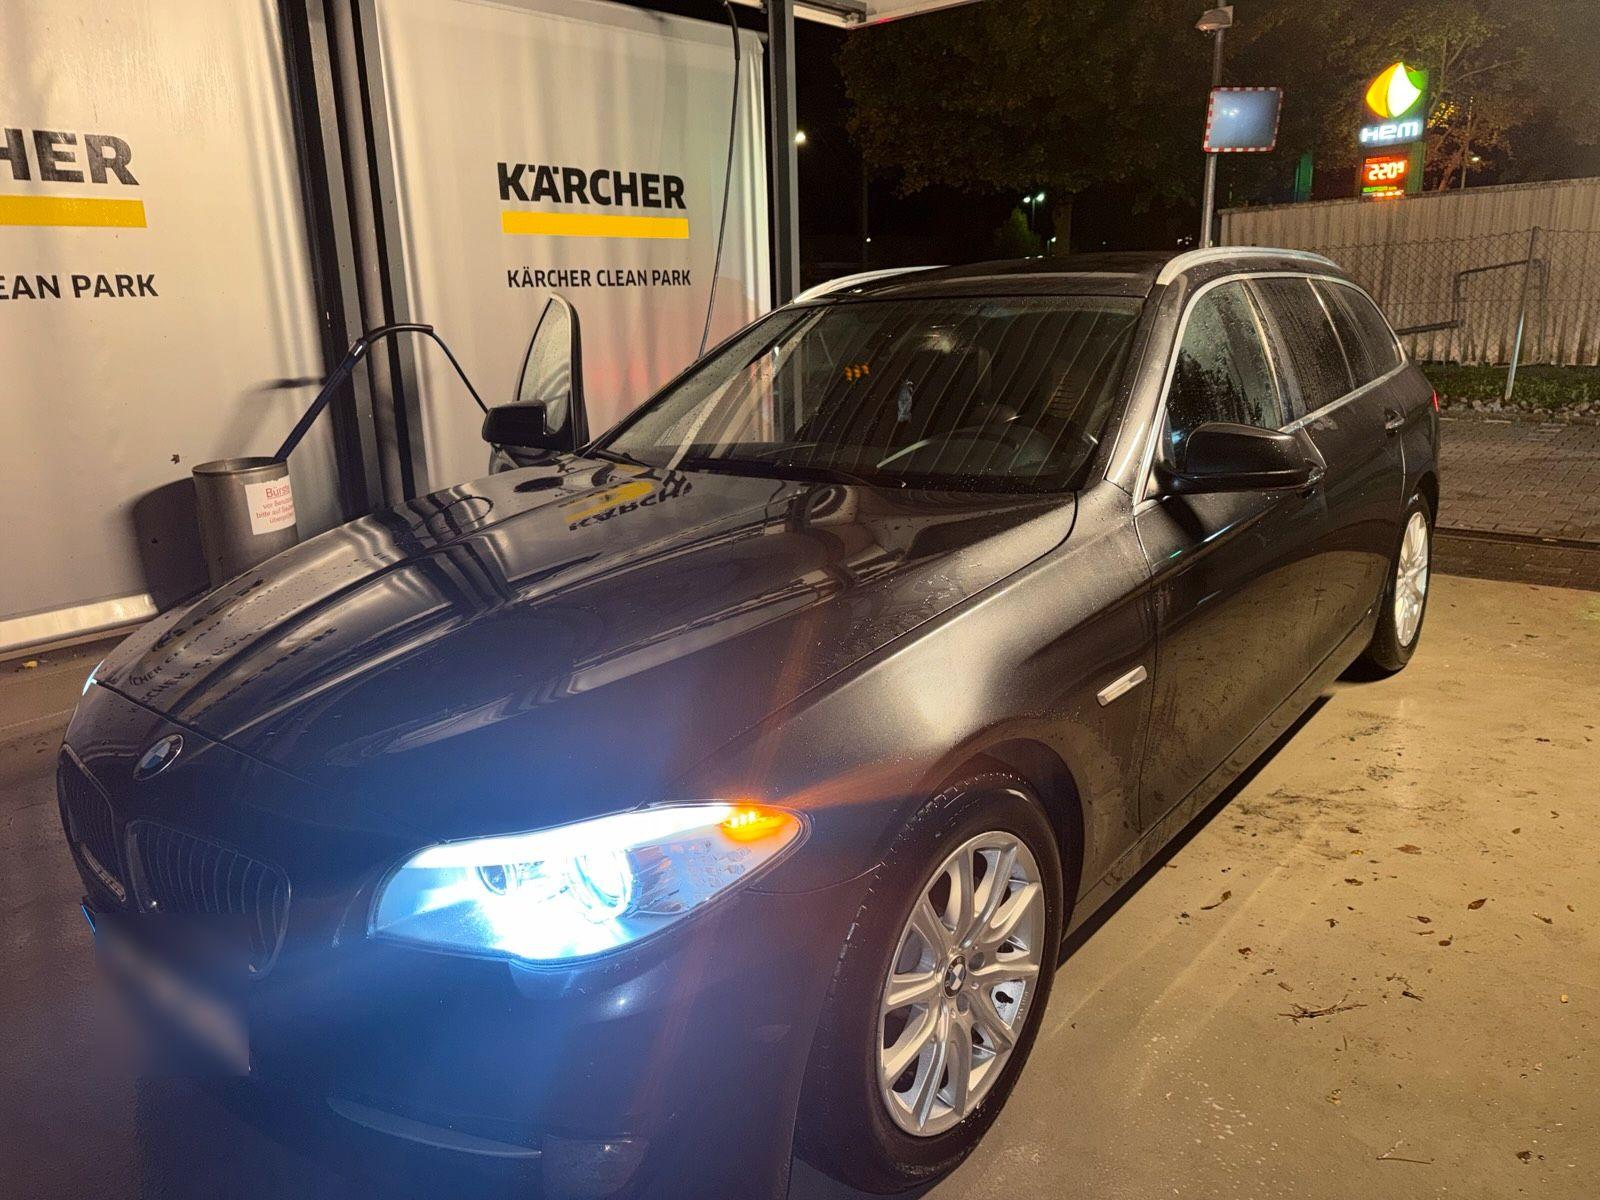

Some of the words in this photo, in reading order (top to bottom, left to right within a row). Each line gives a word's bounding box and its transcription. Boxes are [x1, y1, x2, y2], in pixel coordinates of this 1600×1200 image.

[497, 162, 687, 209] KÄRCHER
[71, 274, 159, 298] PARK
[507, 266, 592, 288] KÄRCHER
[596, 269, 648, 287] CLEAN
[652, 269, 691, 286] PARK
